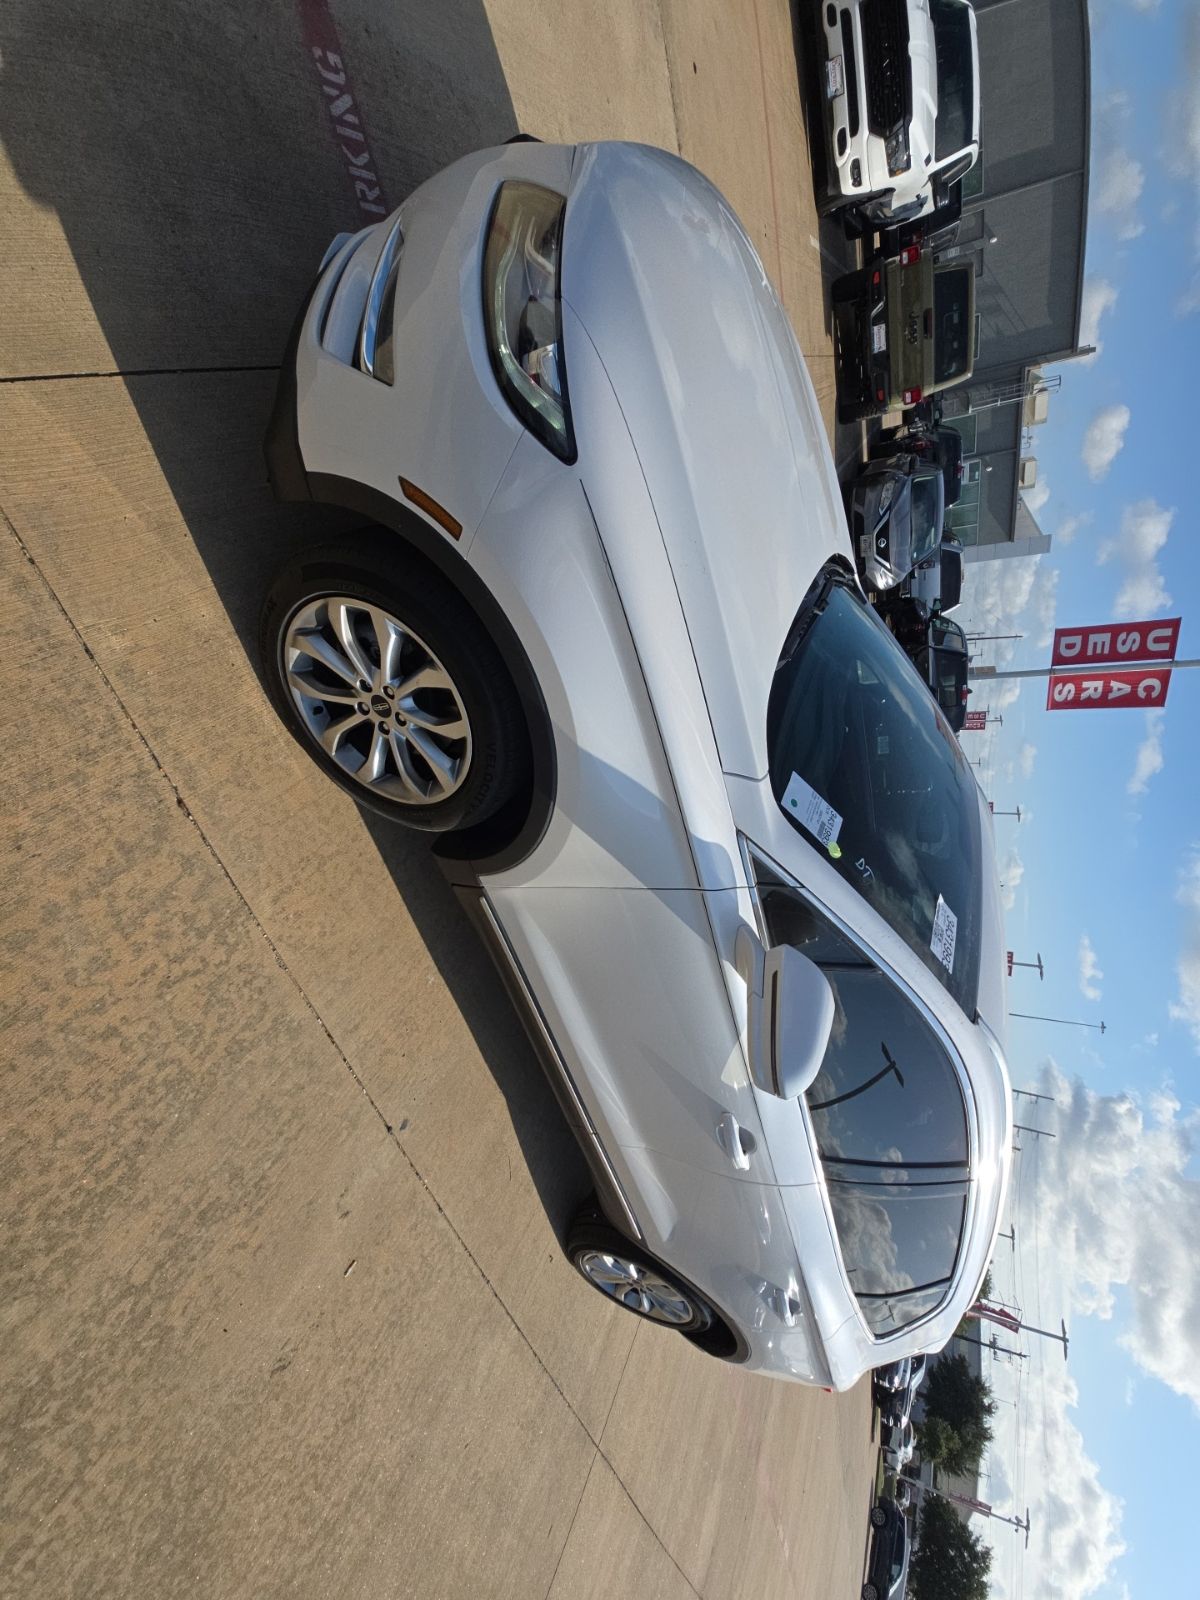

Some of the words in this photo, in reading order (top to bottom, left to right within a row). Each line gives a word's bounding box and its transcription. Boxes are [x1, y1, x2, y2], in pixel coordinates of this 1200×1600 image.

[312, 47, 386, 214] RKING
[1060, 628, 1172, 657] USED
[1054, 678, 1161, 702] CARS
[469, 742, 497, 810] VELOCITY
[822, 810, 837, 846] 3431993
